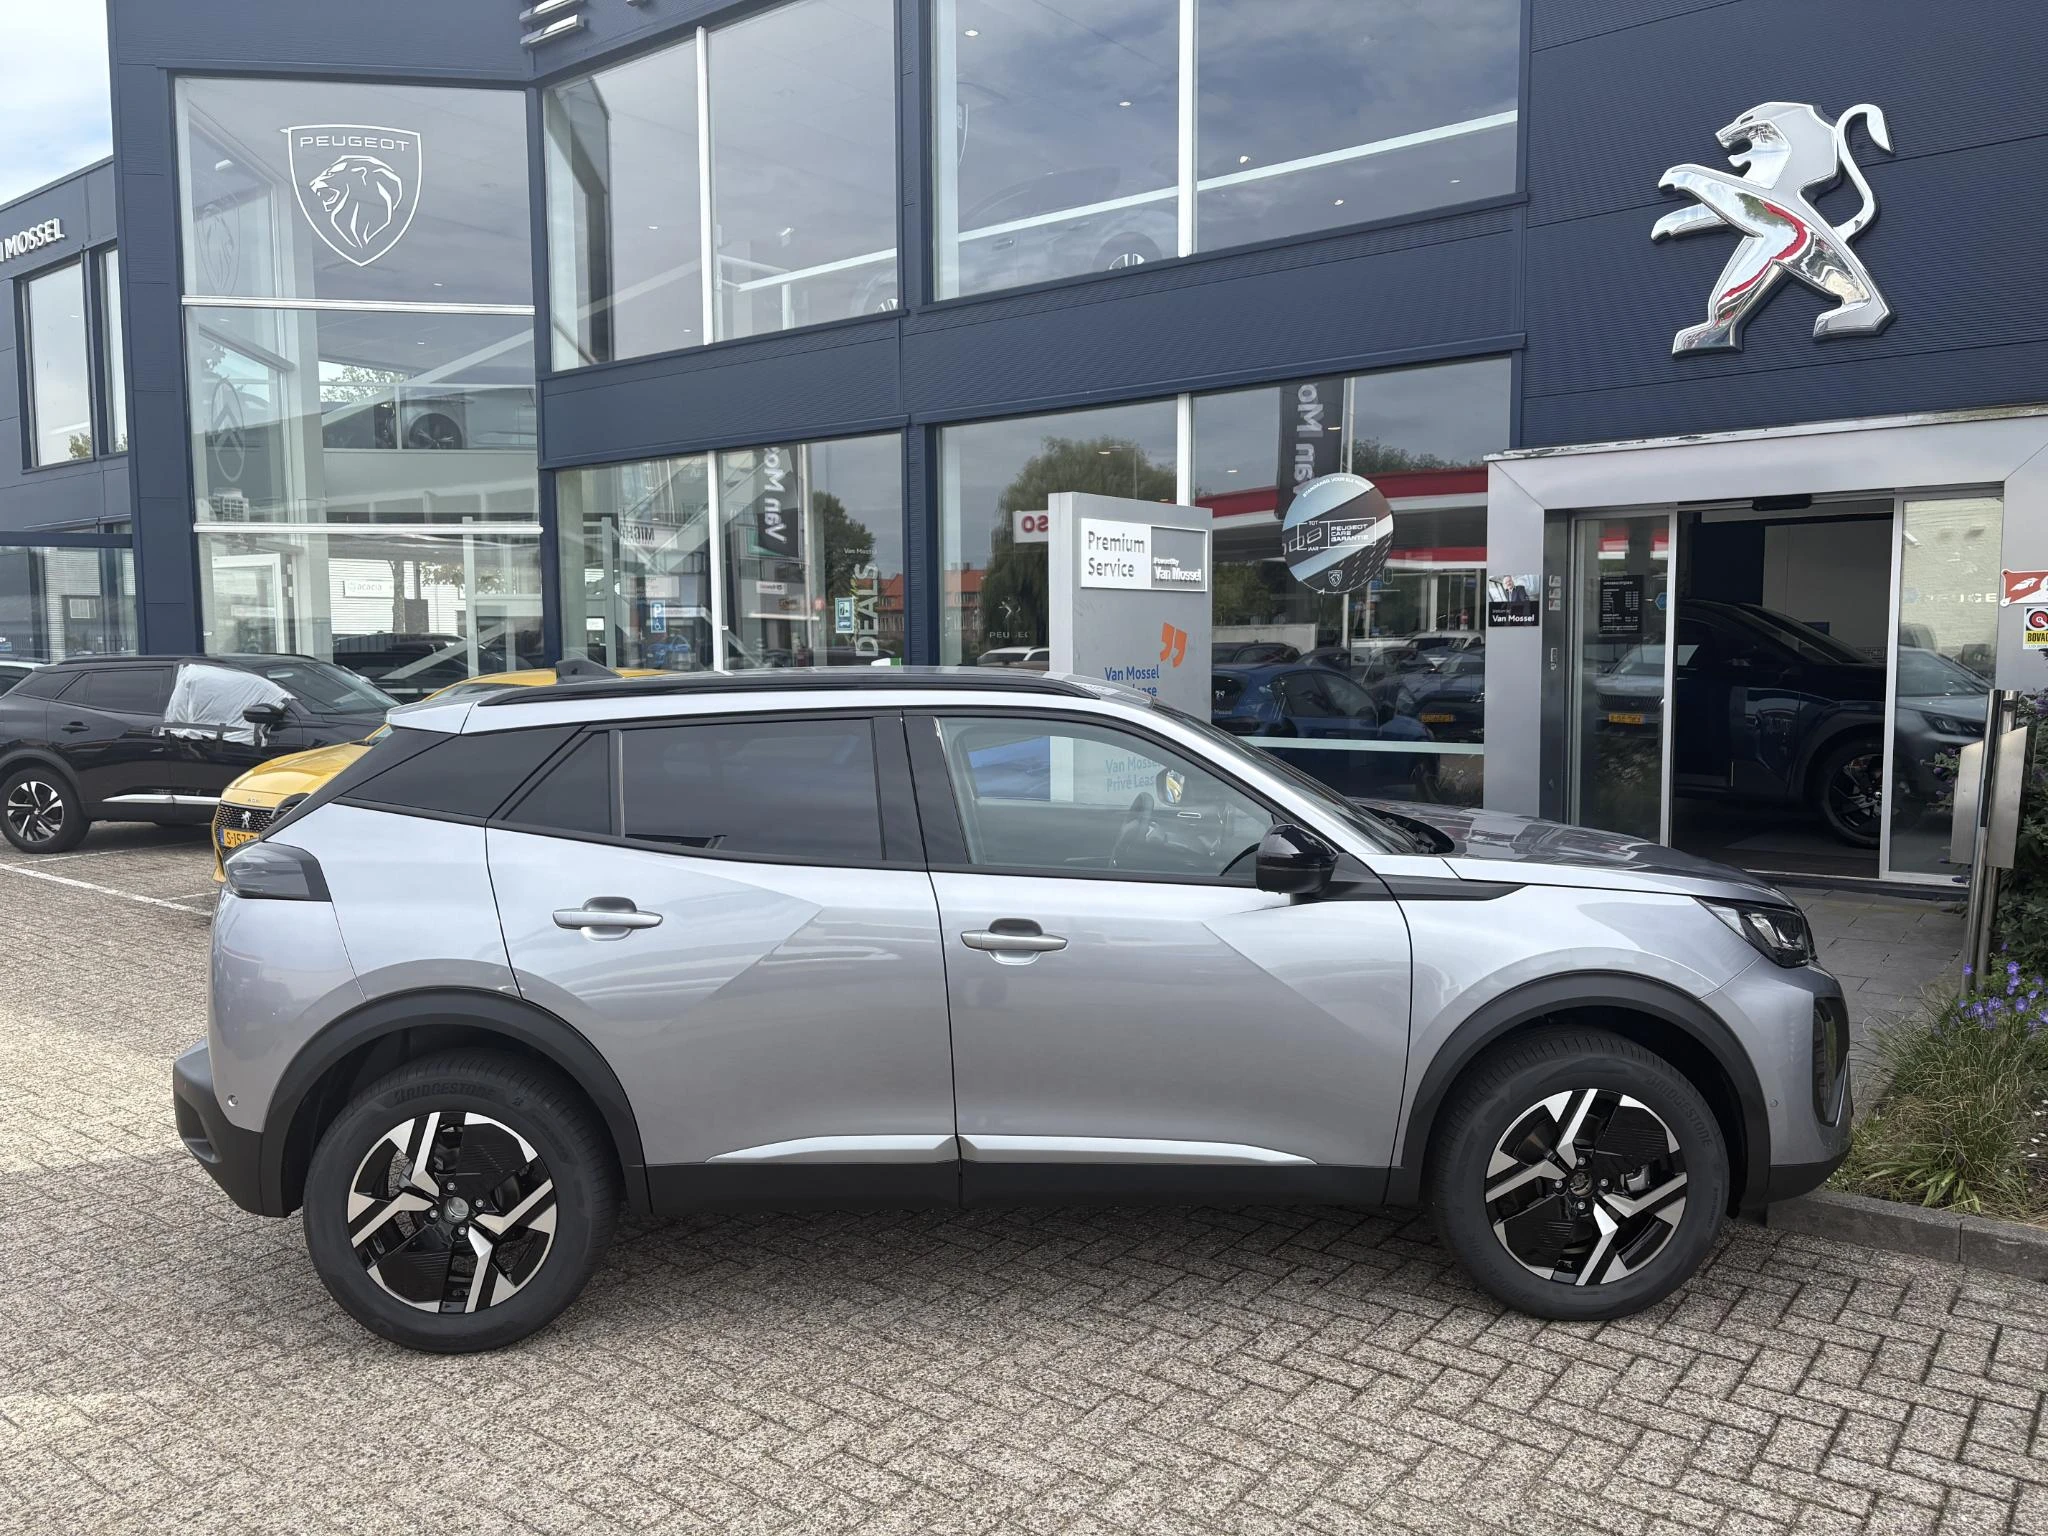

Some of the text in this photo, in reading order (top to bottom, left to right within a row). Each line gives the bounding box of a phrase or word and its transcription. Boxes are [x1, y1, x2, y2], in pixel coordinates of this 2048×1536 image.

[300, 135, 410, 152] PEUGEOT
[4, 217, 66, 259] MOSSEL
[1330, 523, 1369, 532] PEUGEOT
[1087, 529, 1146, 554] Premium
[1330, 535, 1370, 543] GARANTIE
[1087, 557, 1135, 578] Service
[1154, 566, 1202, 582] Van Mossel
[855, 563, 879, 657] DEALS
[1492, 613, 1535, 622] Van Mossel
[1104, 664, 1160, 682] Van Mossel
[1105, 759, 1125, 774] Van
[1106, 774, 1132, 793] Privé
[393, 1081, 497, 1106] BRIDGESTONE
[1646, 1077, 1713, 1148] BRIDGESTONE
